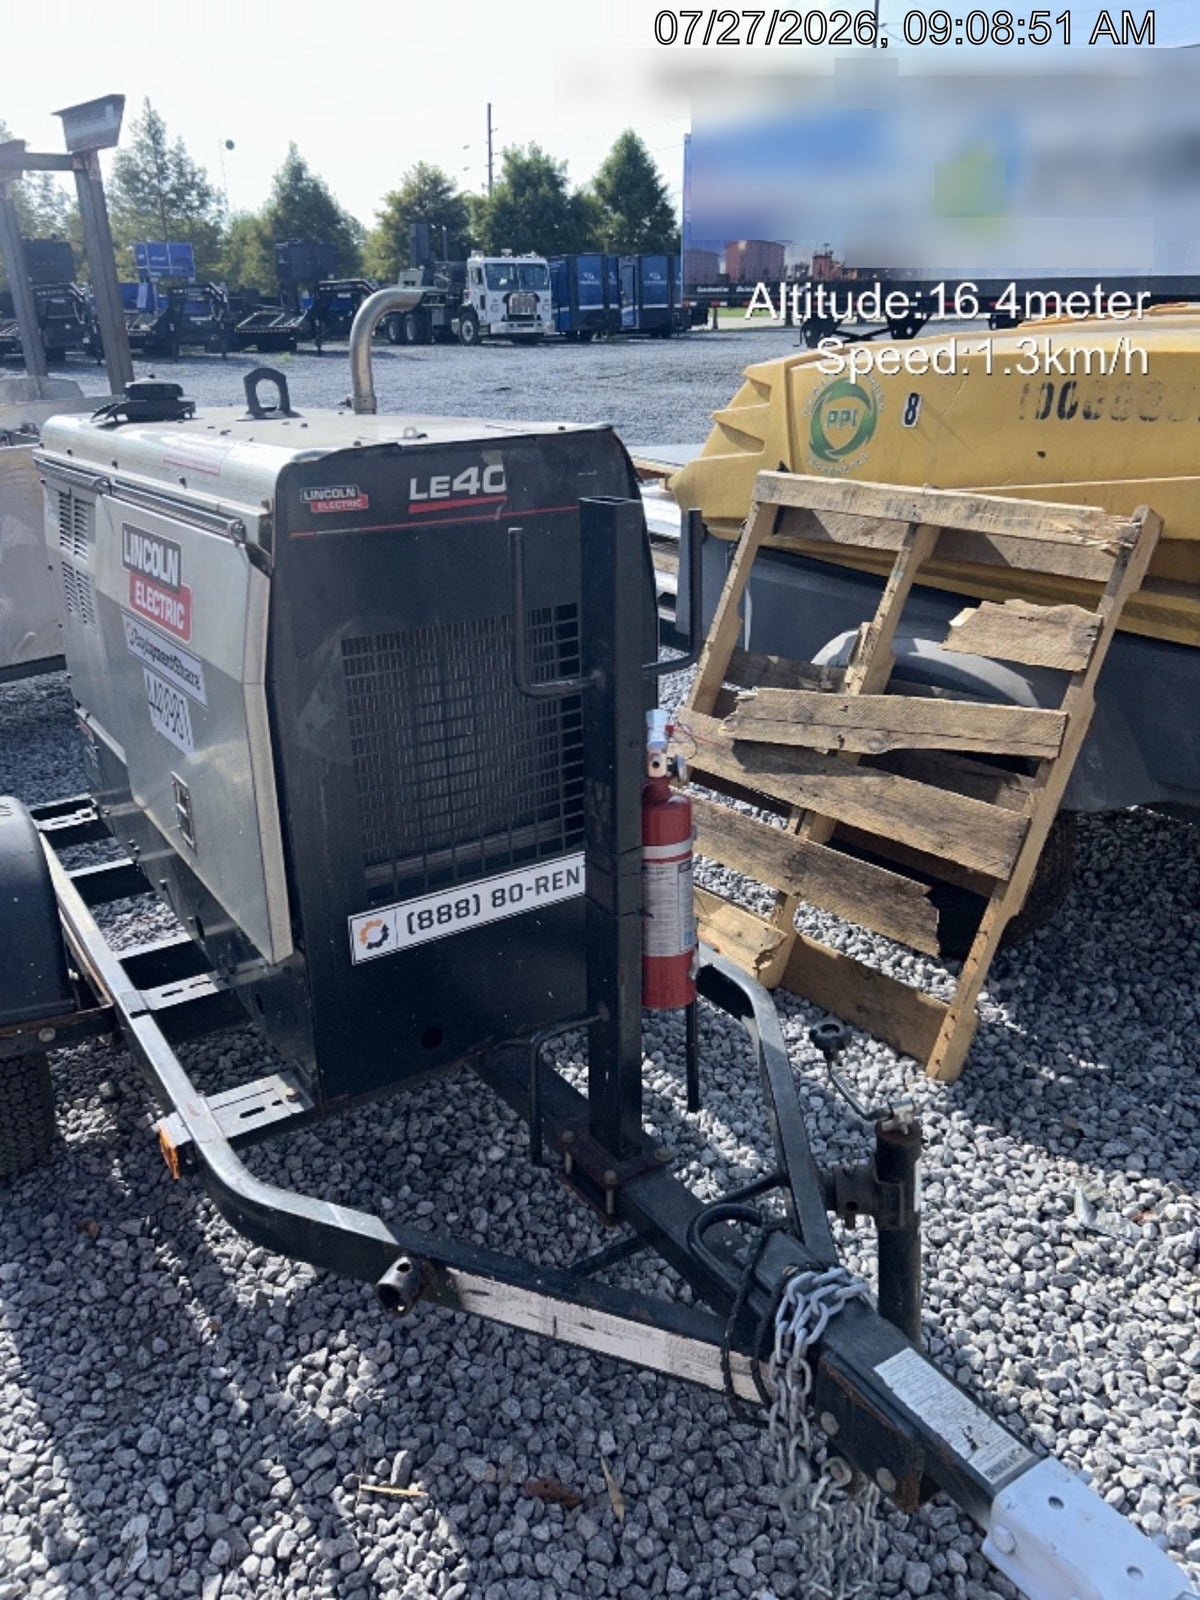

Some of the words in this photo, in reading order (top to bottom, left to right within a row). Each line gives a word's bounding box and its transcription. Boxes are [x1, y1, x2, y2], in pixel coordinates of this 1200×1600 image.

[903, 392, 921, 427] 8
[303, 487, 358, 500] LINCOLN
[317, 500, 363, 510] ELECTRIC
[123, 529, 179, 588] LINCOLN
[135, 580, 185, 630] ELECTRIC
[491, 863, 586, 908] 80-REN
